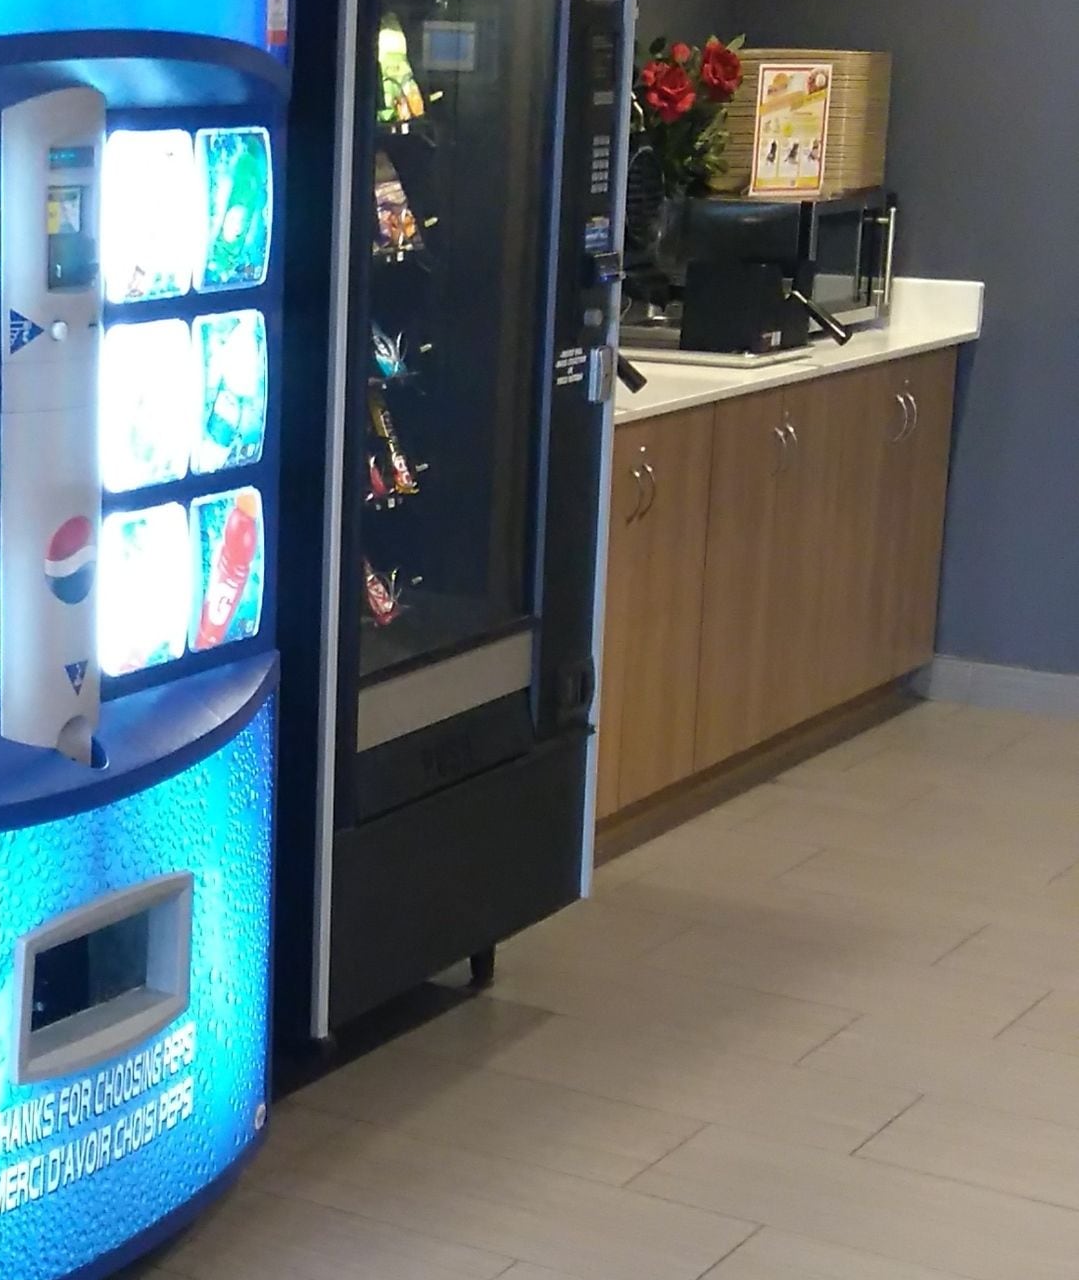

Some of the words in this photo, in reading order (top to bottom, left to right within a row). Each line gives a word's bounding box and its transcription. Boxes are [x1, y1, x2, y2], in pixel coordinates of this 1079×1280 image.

[58, 1078, 93, 1132] FOR
[94, 1042, 163, 1115] CHOOSING
[47, 1125, 112, 1193] D'AVOIR
[113, 1099, 158, 1161] CHOISI
